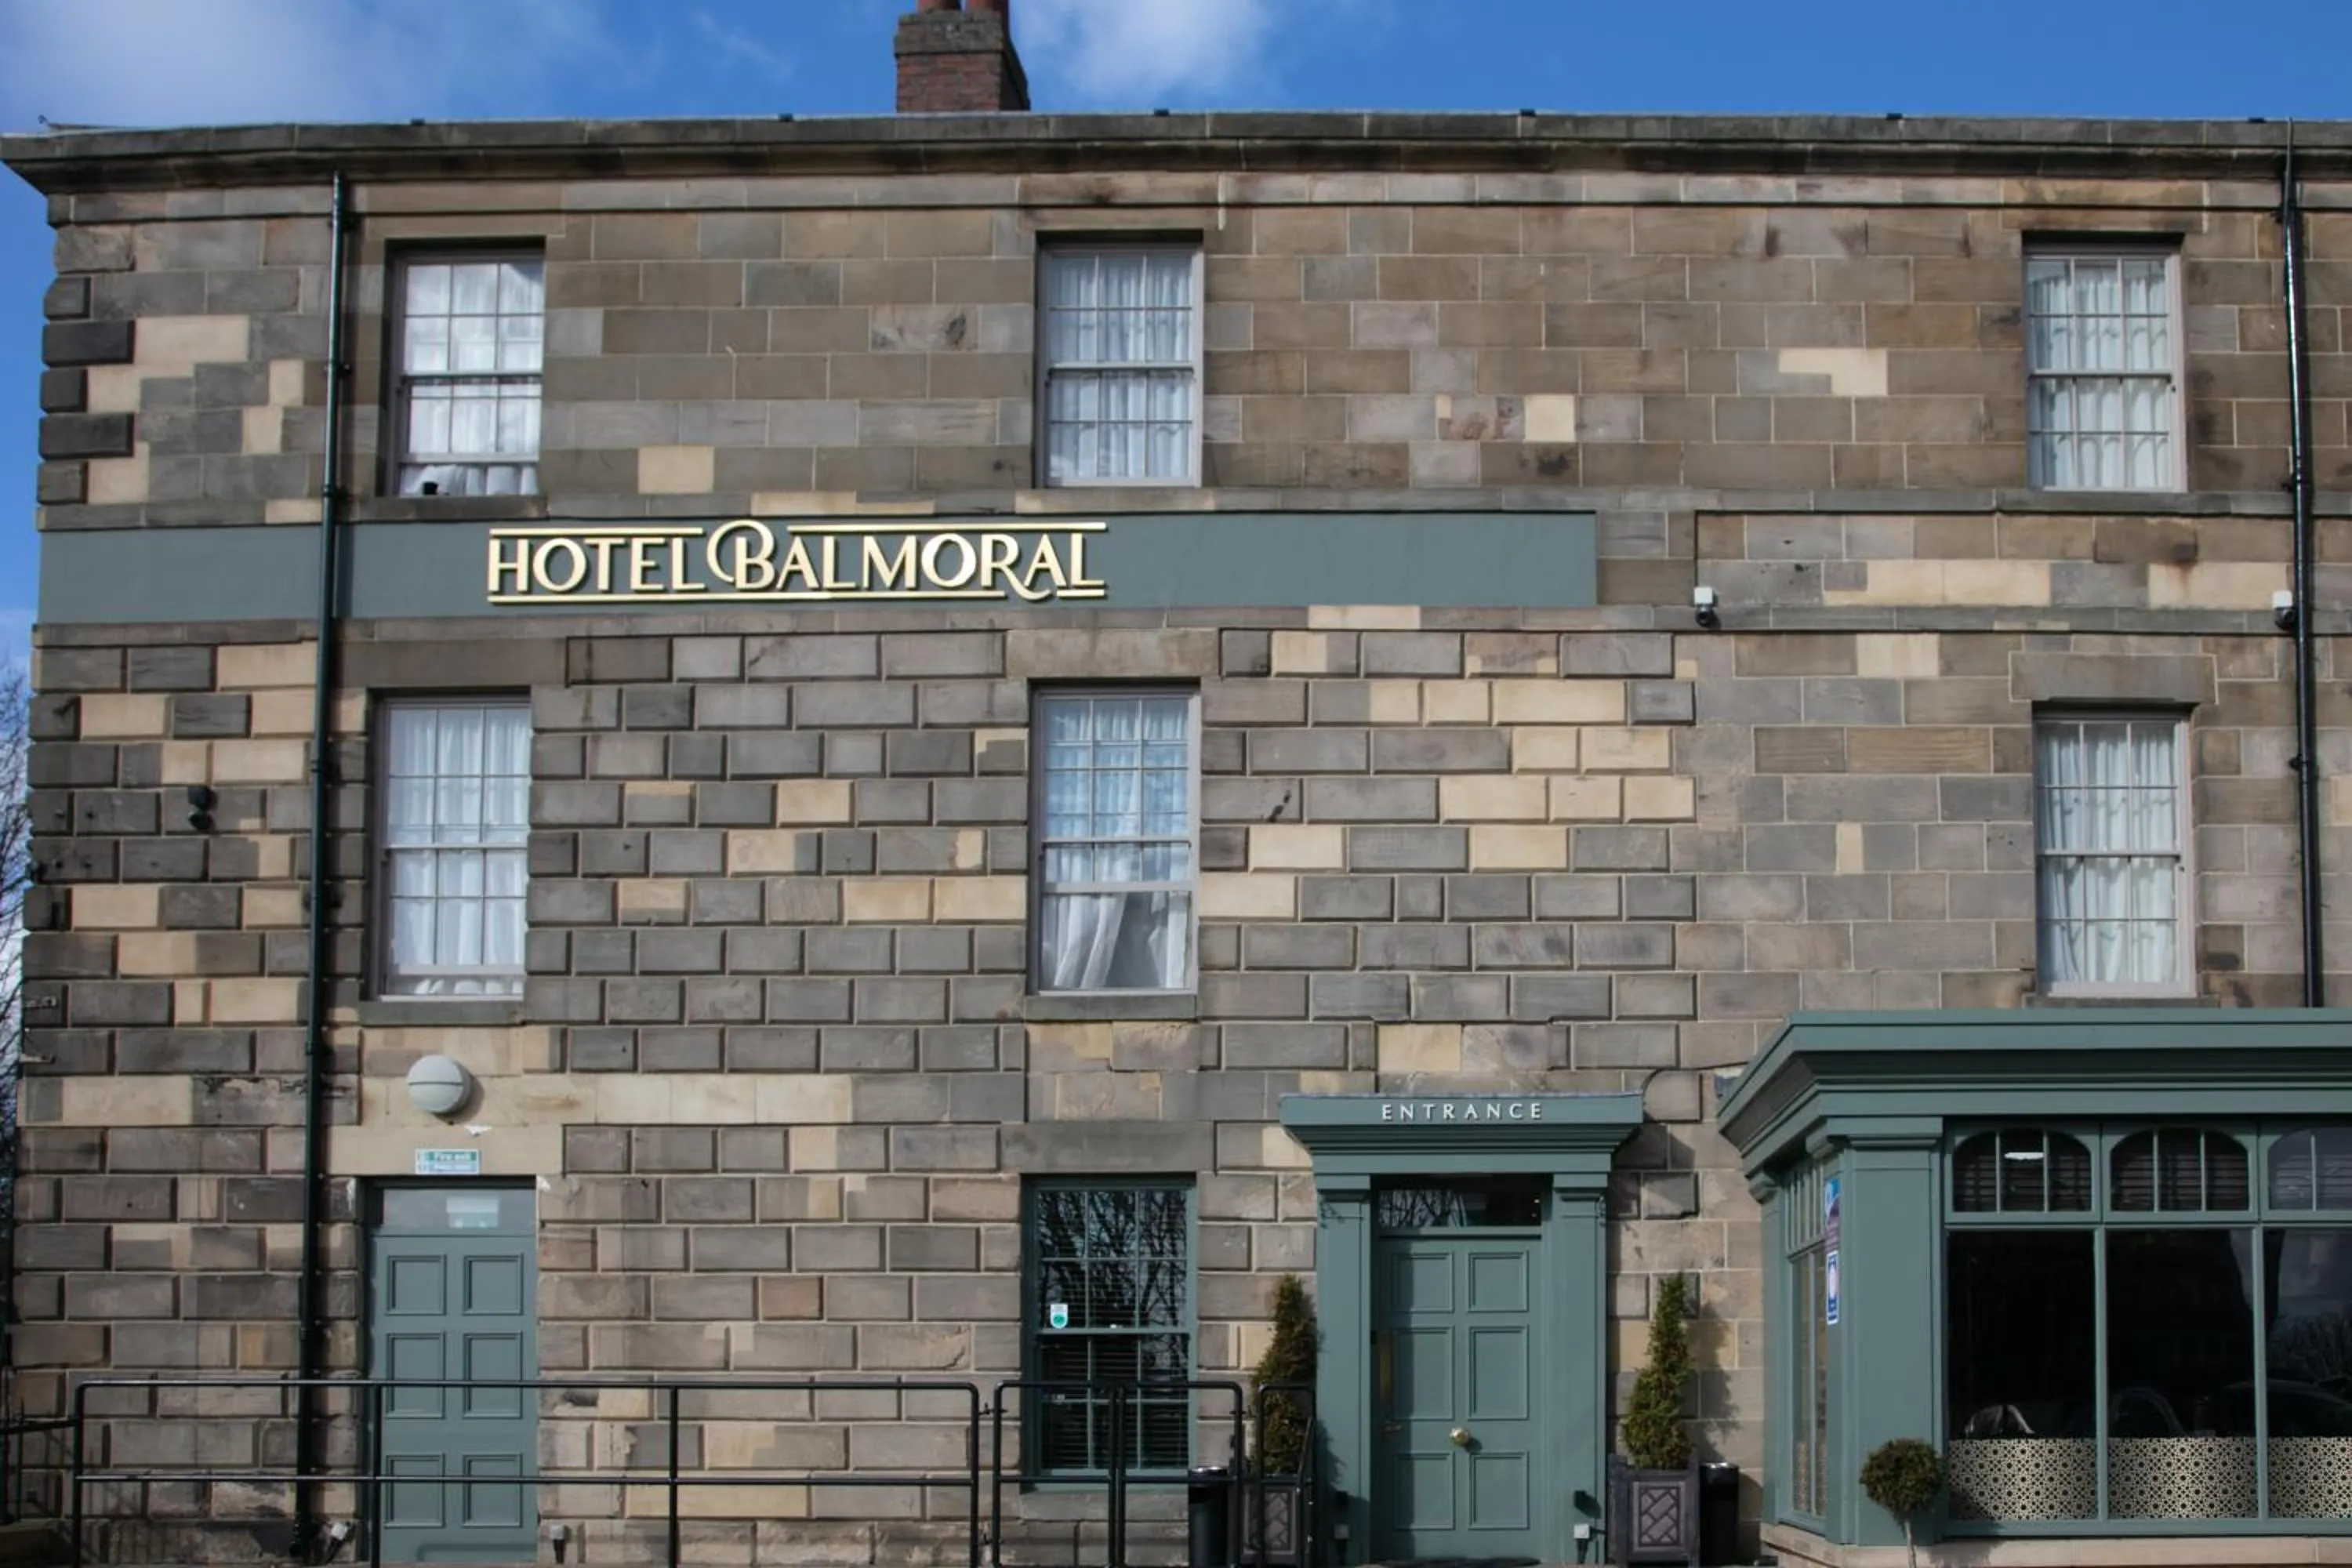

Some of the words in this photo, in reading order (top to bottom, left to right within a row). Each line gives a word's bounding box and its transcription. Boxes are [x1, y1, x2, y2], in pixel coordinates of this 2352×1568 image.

[488, 536, 706, 593] HOTEL
[706, 519, 1105, 601] BALMORAL
[1381, 1103, 1542, 1120] ENTRANCE
